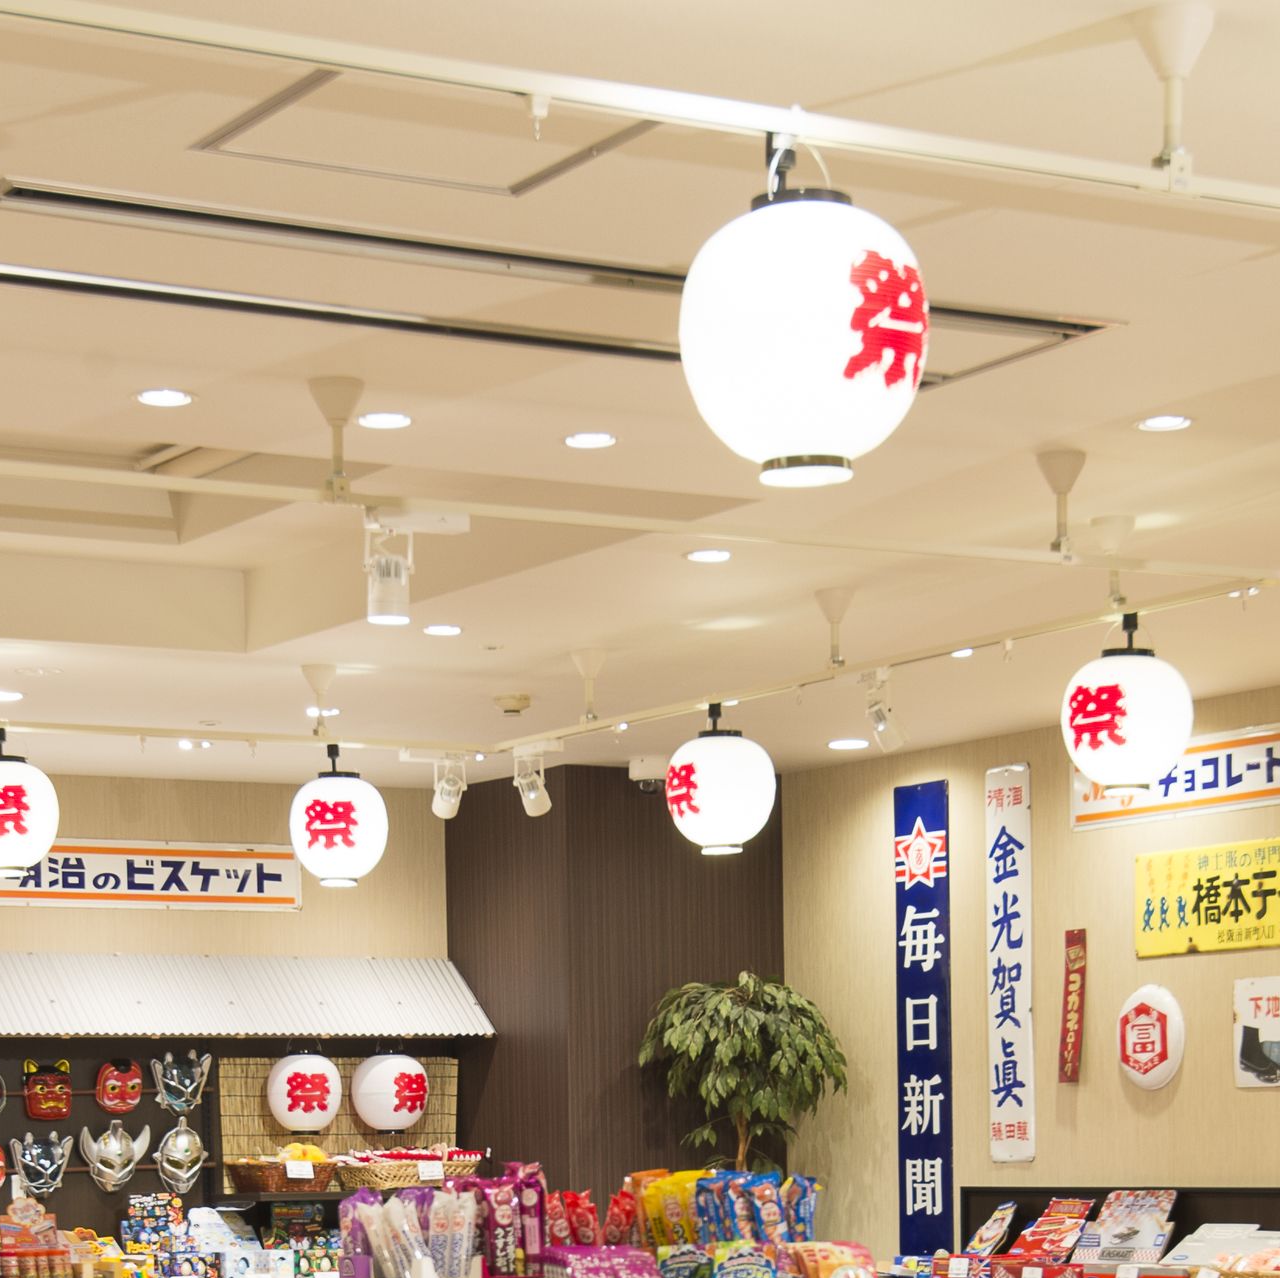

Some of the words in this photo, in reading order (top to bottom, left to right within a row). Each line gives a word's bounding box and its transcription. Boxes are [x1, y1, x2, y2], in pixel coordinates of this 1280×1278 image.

[844, 255, 928, 387] 祭
[1069, 684, 1126, 750] 祭
[305, 800, 359, 850] 祭
[898, 905, 947, 1217] 毎日新聞
[287, 1071, 330, 1113] 祭
[393, 1072, 427, 1113] 祭
